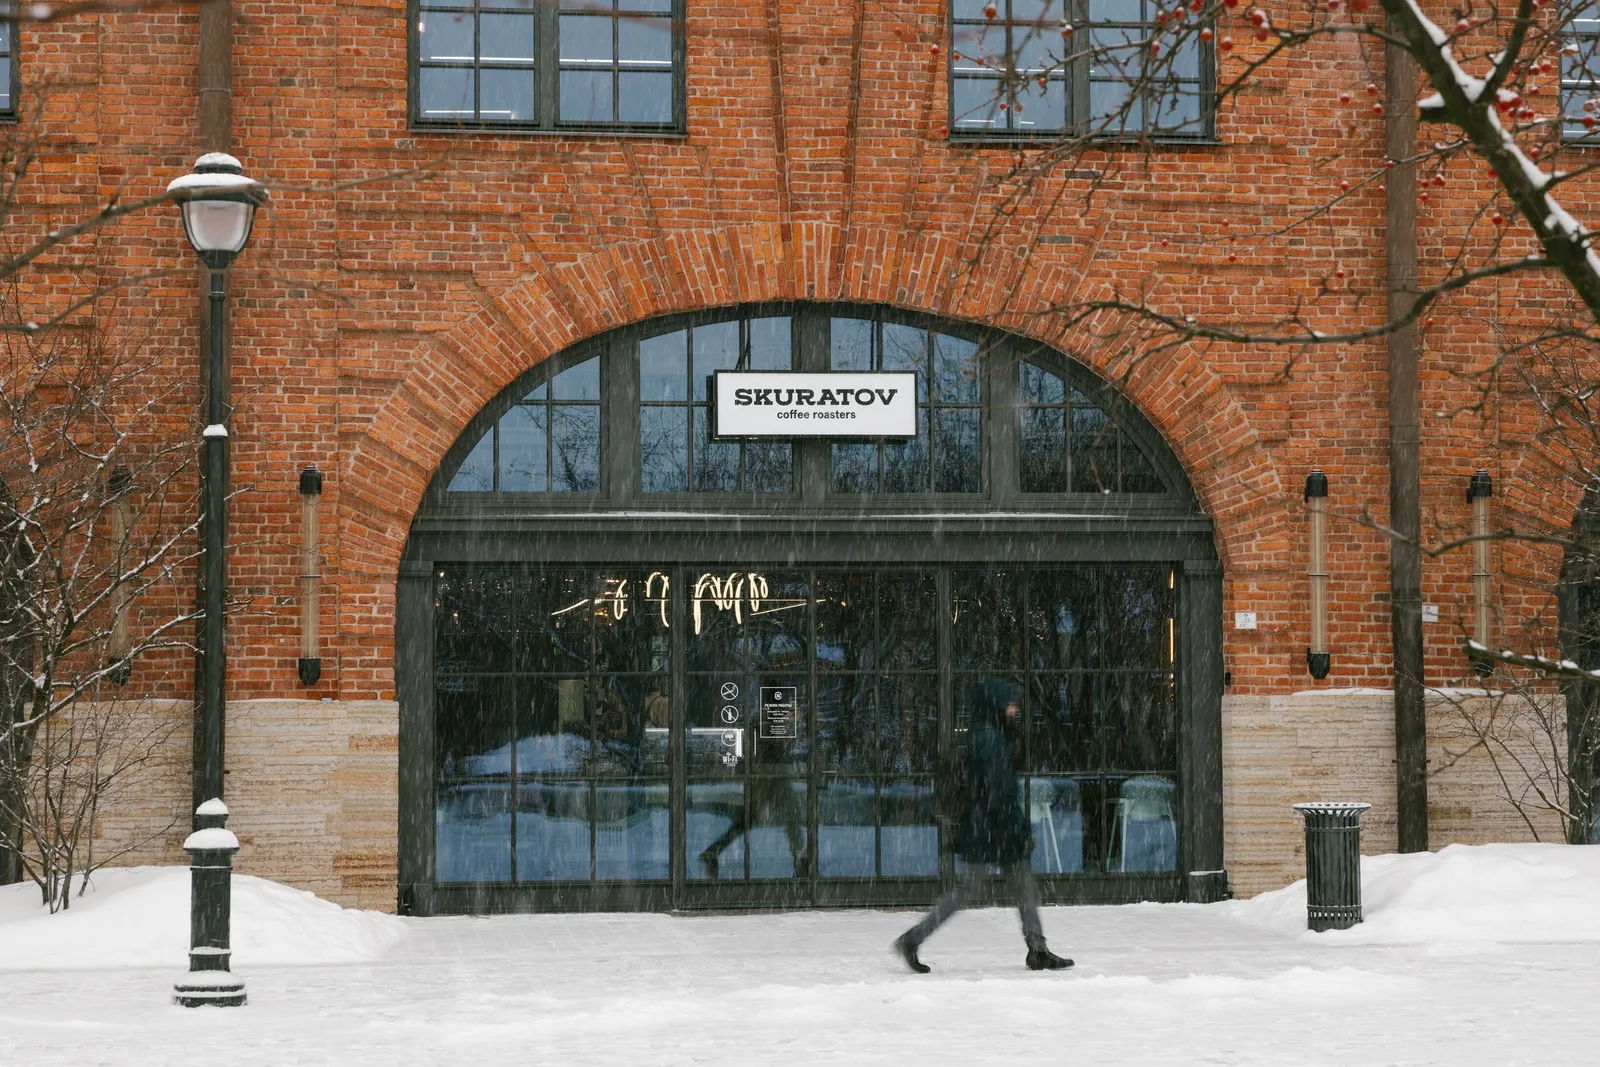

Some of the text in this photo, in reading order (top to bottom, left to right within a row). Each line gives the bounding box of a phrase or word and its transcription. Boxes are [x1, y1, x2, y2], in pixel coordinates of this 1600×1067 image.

[734, 388, 898, 406] SKURATOV
[776, 409, 856, 419] coffee roasters
